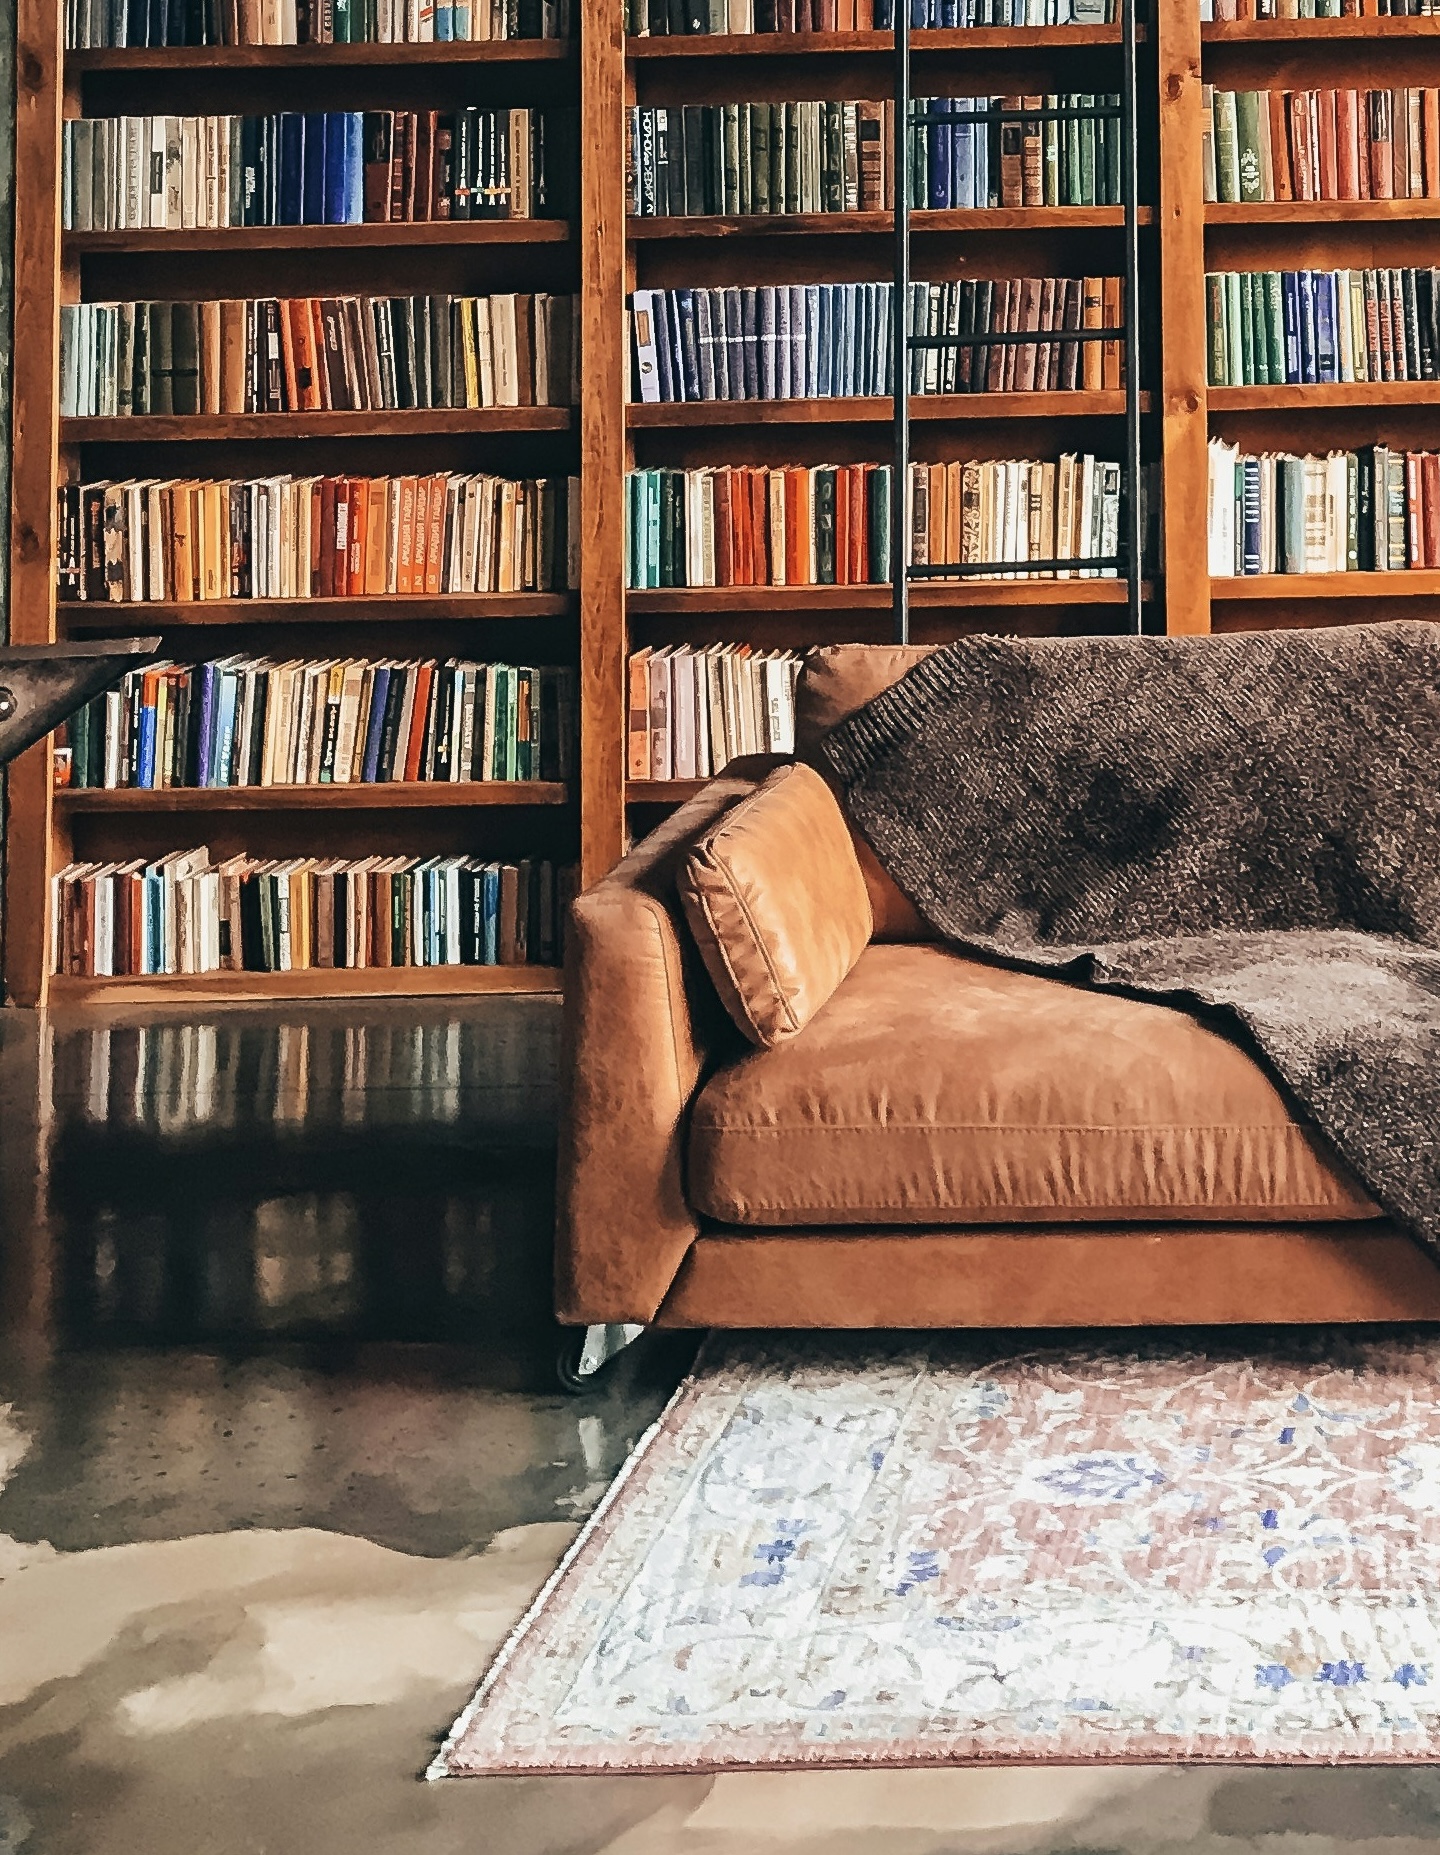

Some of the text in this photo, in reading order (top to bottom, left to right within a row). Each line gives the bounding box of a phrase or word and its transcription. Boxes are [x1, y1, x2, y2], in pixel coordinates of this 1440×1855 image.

[402, 488, 413, 566] АРКАДИЙ ГАЙДАР
[415, 486, 426, 564] АРКАДИЙ ГАЙДАР
[430, 486, 442, 564] АРКАДИЙ ГАЙДАР
